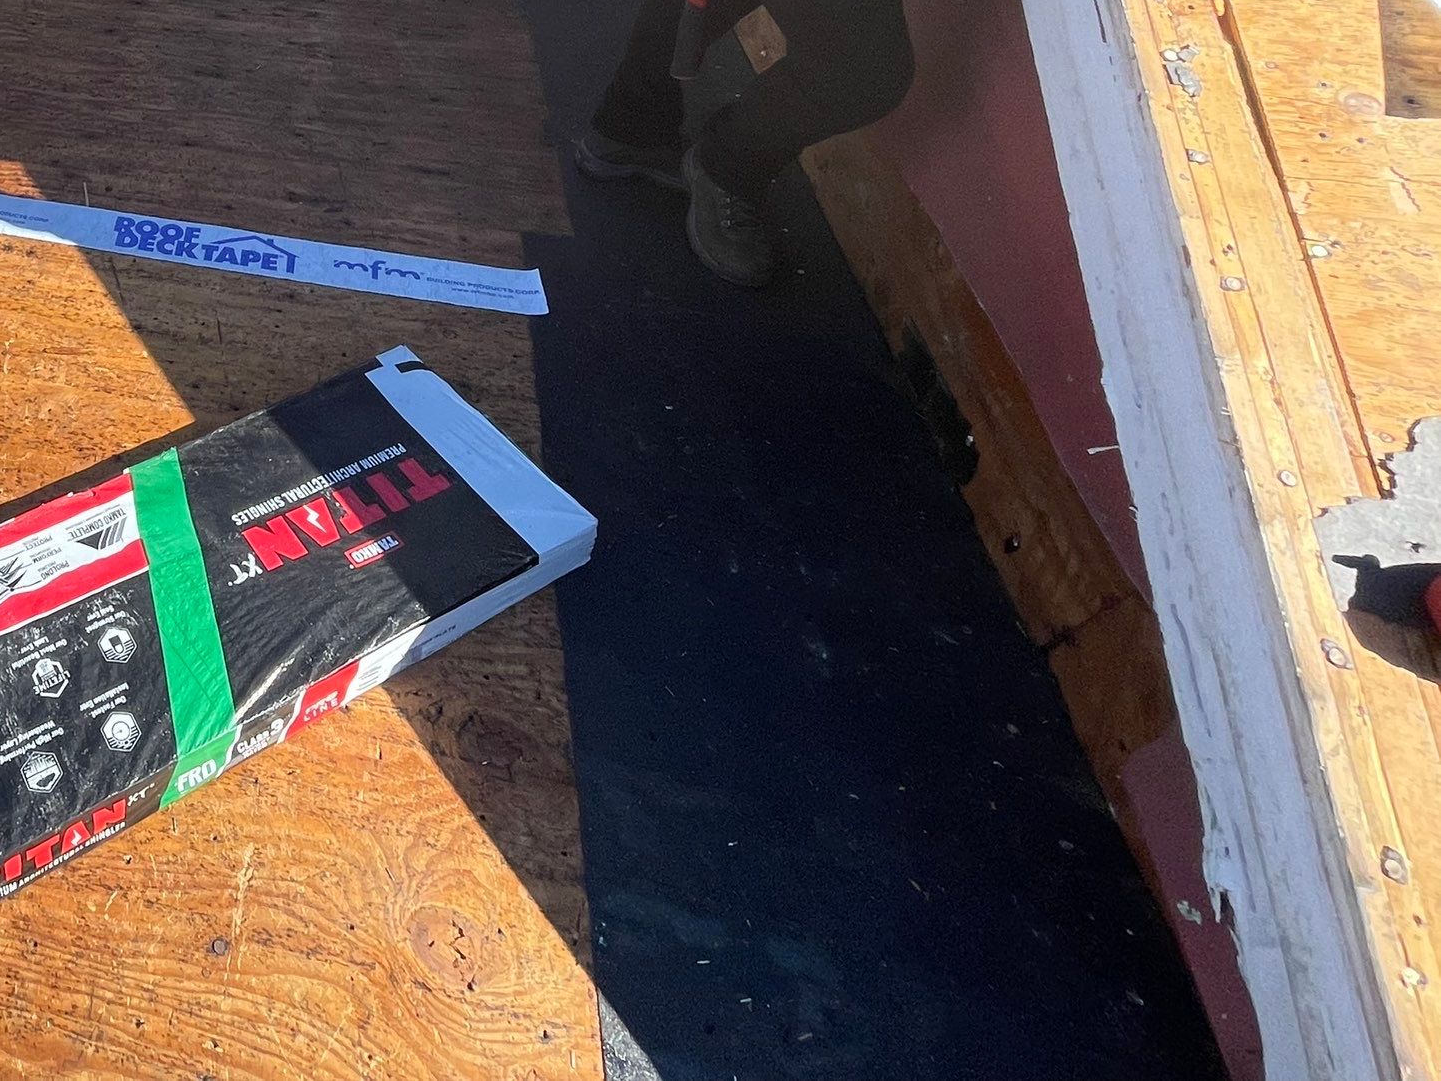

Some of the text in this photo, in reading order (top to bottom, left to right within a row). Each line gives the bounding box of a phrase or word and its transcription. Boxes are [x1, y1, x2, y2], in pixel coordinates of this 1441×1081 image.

[113, 216, 201, 243] ROOF
[114, 231, 279, 270] DECK TAPE
[333, 259, 421, 280] mfm
[231, 443, 407, 526] PREMIUM ARCHITECTURAL SHINGLES
[229, 457, 452, 586] TITAN XT
[352, 534, 399, 563] TAMKO
[33, 670, 71, 695] LIFETIME
